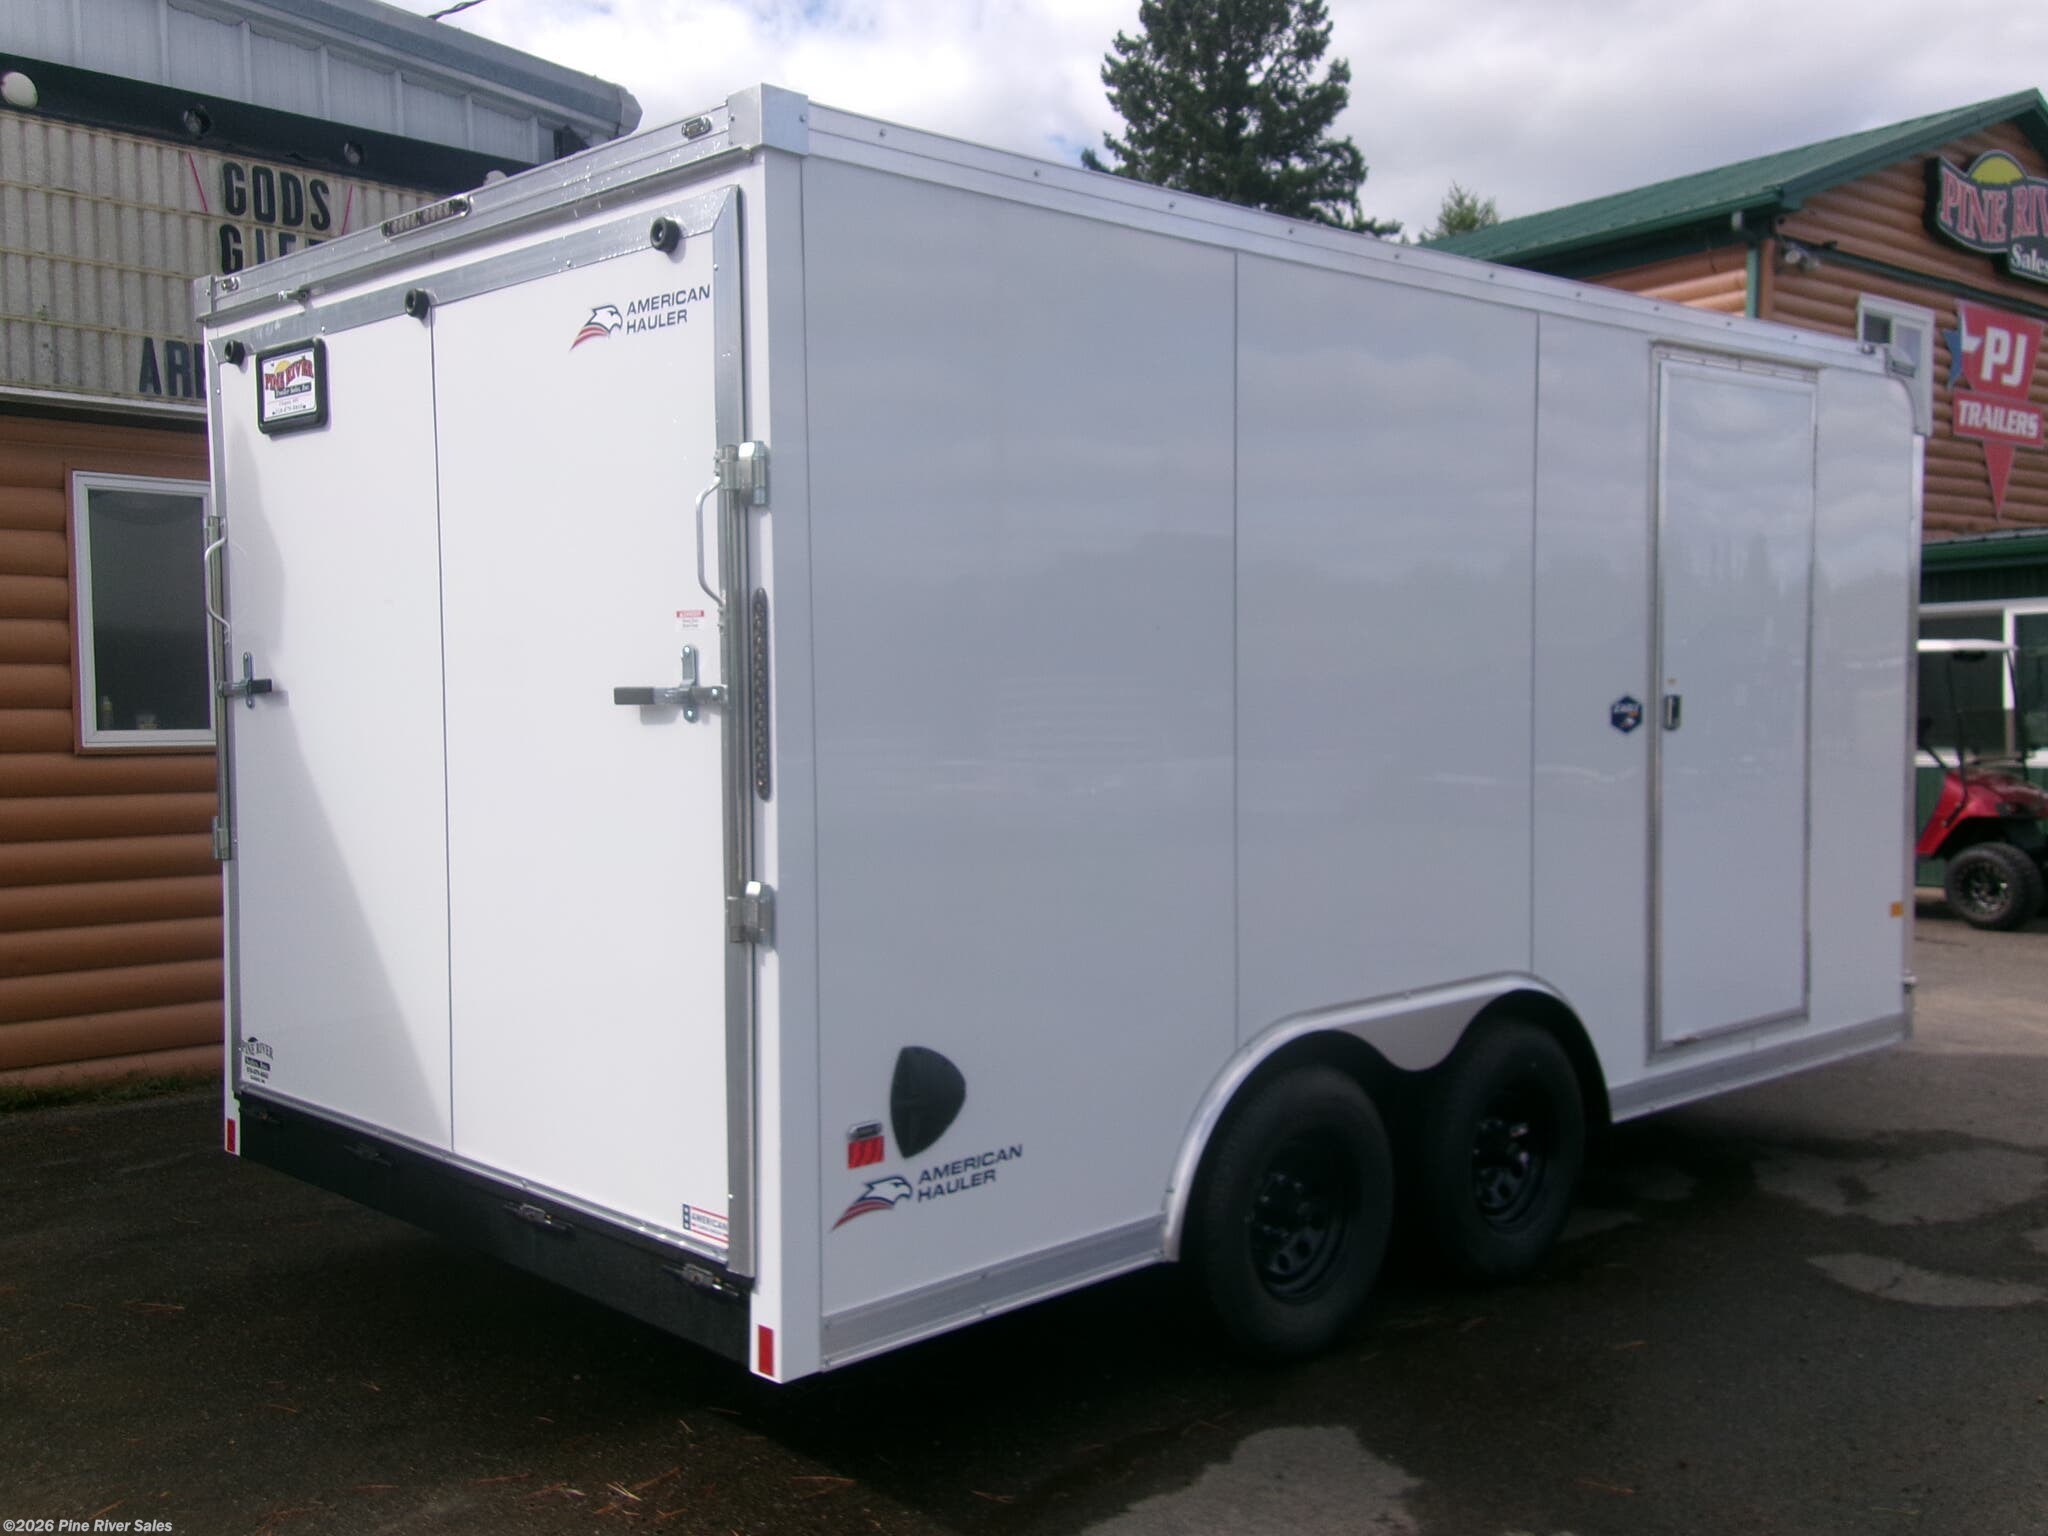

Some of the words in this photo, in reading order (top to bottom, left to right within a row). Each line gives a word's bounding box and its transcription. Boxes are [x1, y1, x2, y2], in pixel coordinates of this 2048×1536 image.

[223, 161, 331, 231] GODS
[1940, 169, 2008, 243] PINE
[626, 284, 711, 317] AMERICAN
[626, 310, 688, 335] HAULER
[1980, 326, 2028, 388] PJ
[1958, 400, 2039, 439] TRAILERS
[917, 1144, 1024, 1185] AMERICAN
[917, 1169, 997, 1203] HAULER
